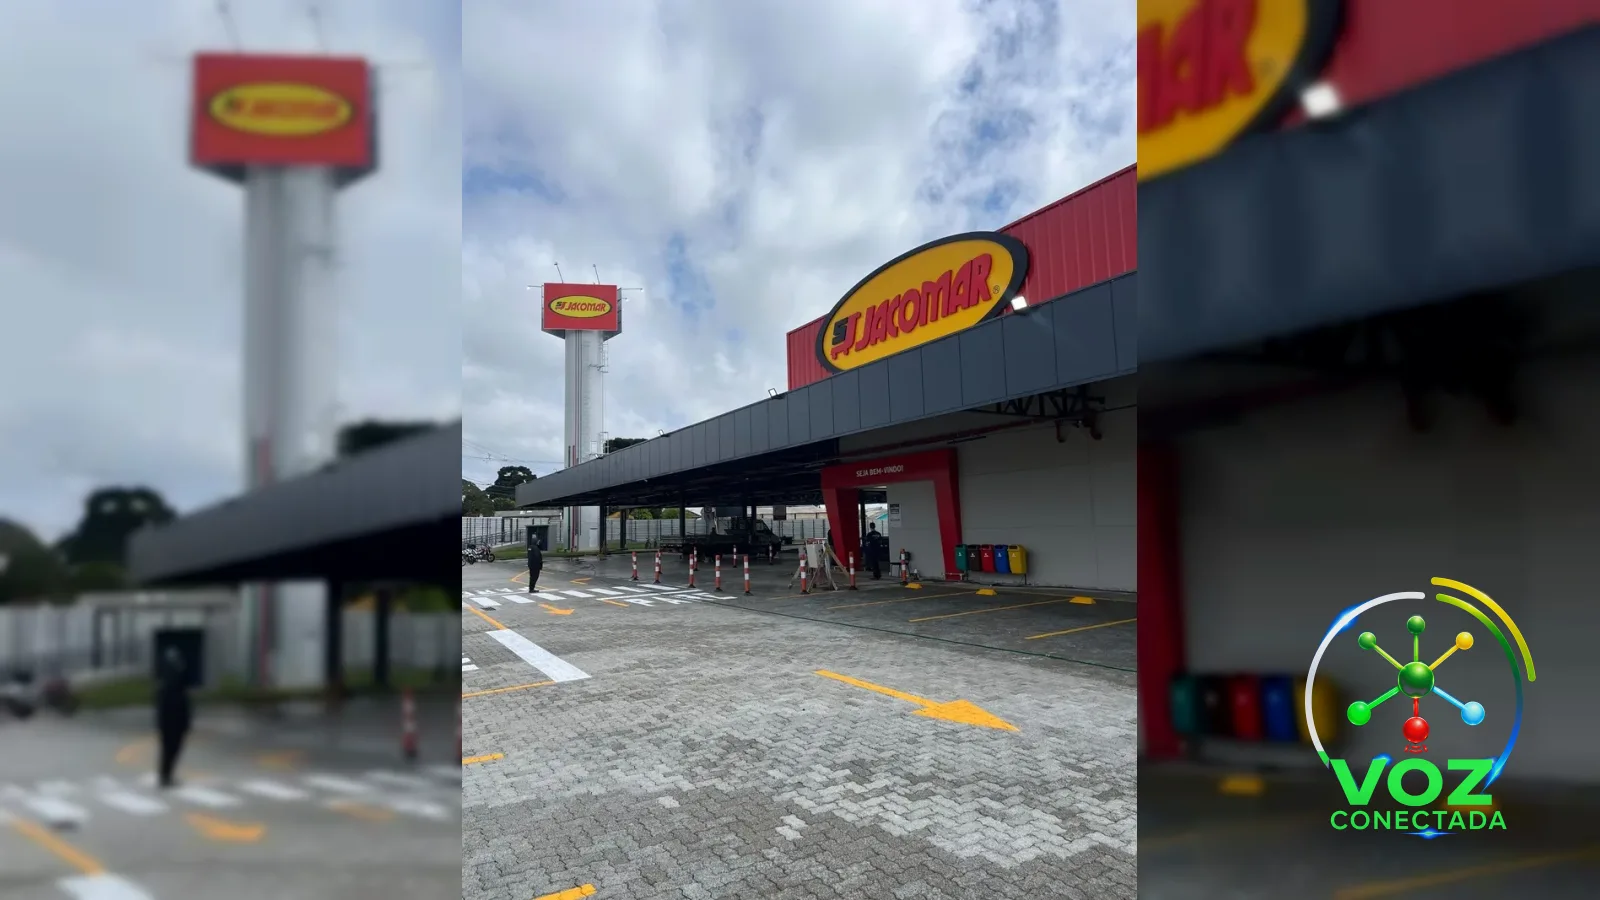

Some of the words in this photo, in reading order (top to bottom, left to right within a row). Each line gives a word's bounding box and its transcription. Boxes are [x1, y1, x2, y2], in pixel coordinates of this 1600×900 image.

[564, 301, 607, 312] JACOMAR
[854, 252, 993, 352] JACOMAR
[856, 469, 869, 478] SEJA
